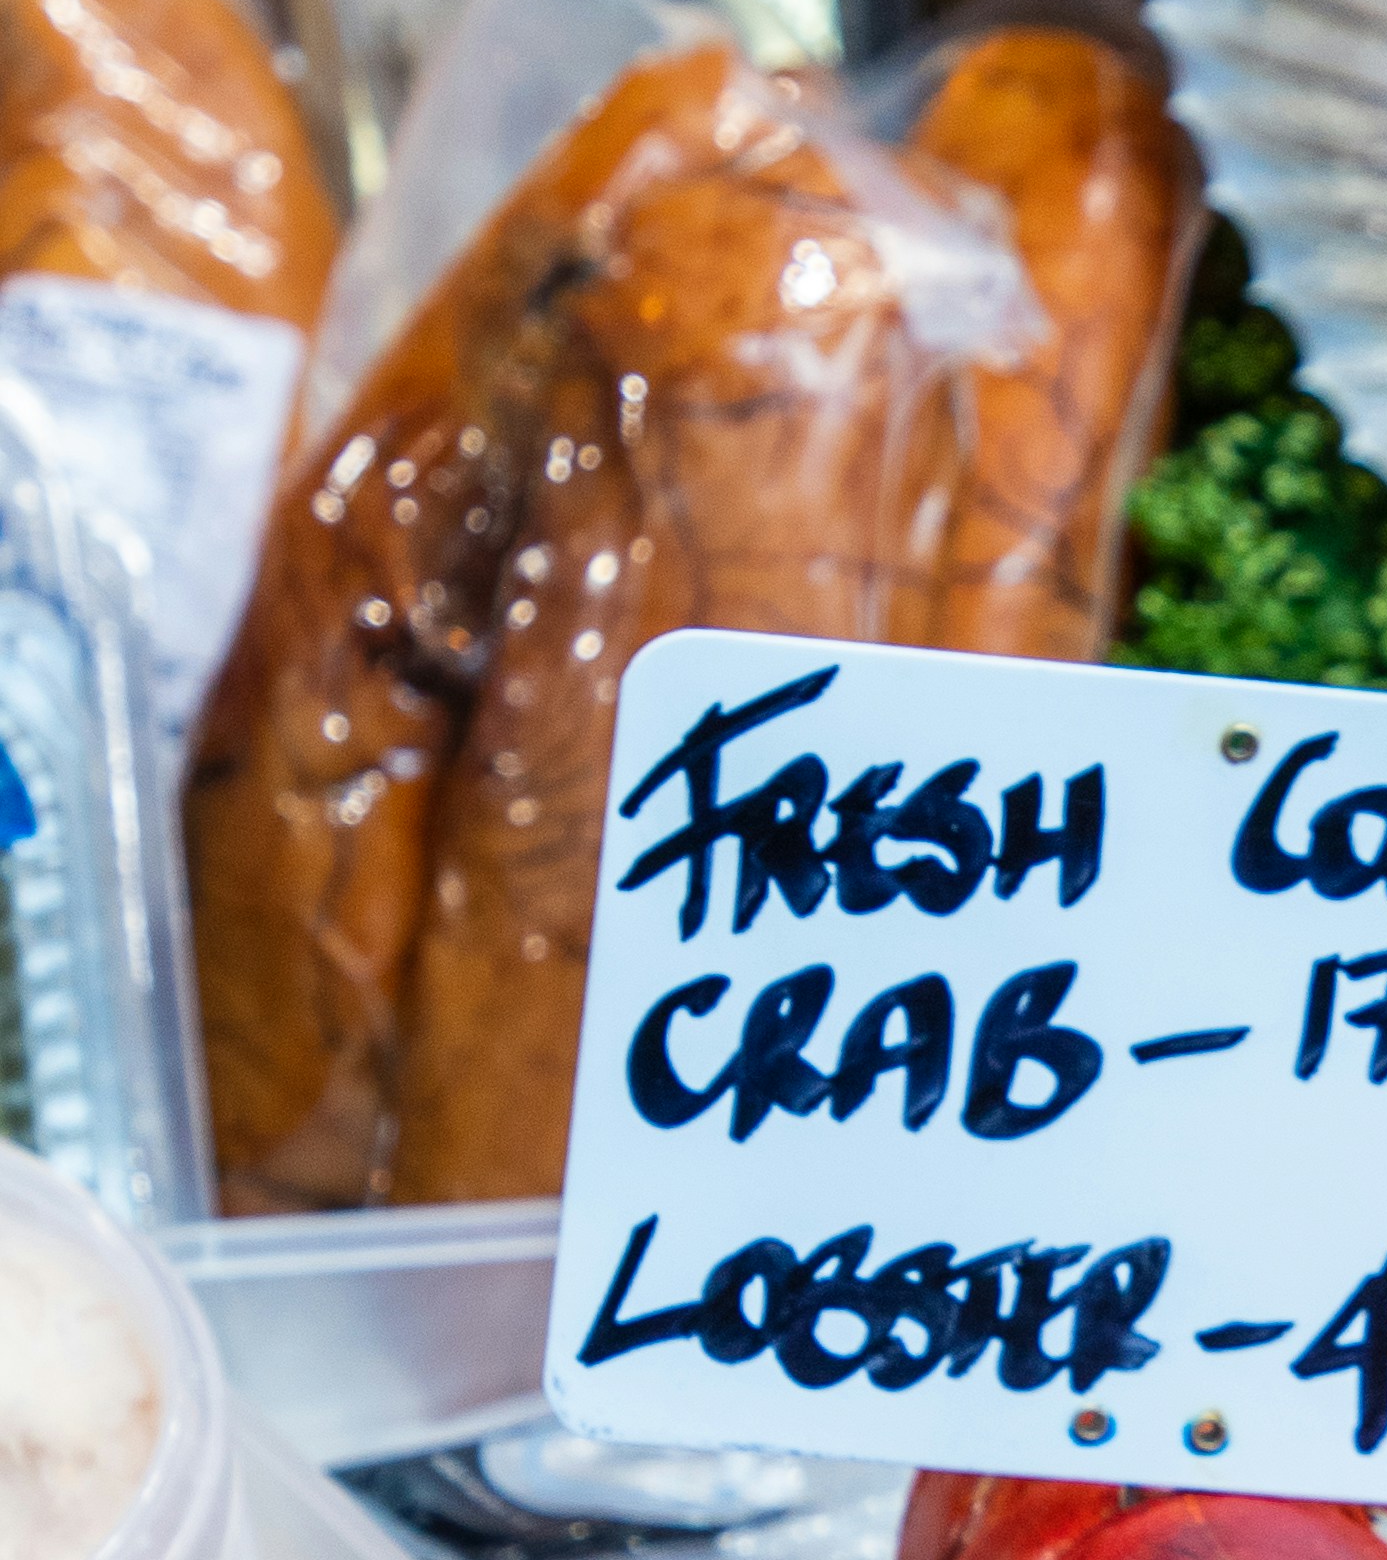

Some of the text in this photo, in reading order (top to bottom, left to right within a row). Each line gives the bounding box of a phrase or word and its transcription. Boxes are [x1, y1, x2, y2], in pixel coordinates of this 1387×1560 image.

[616, 664, 1106, 943] FRESH
[626, 960, 1104, 1144] CRAB
[576, 1214, 1172, 1395] LOBSTER
